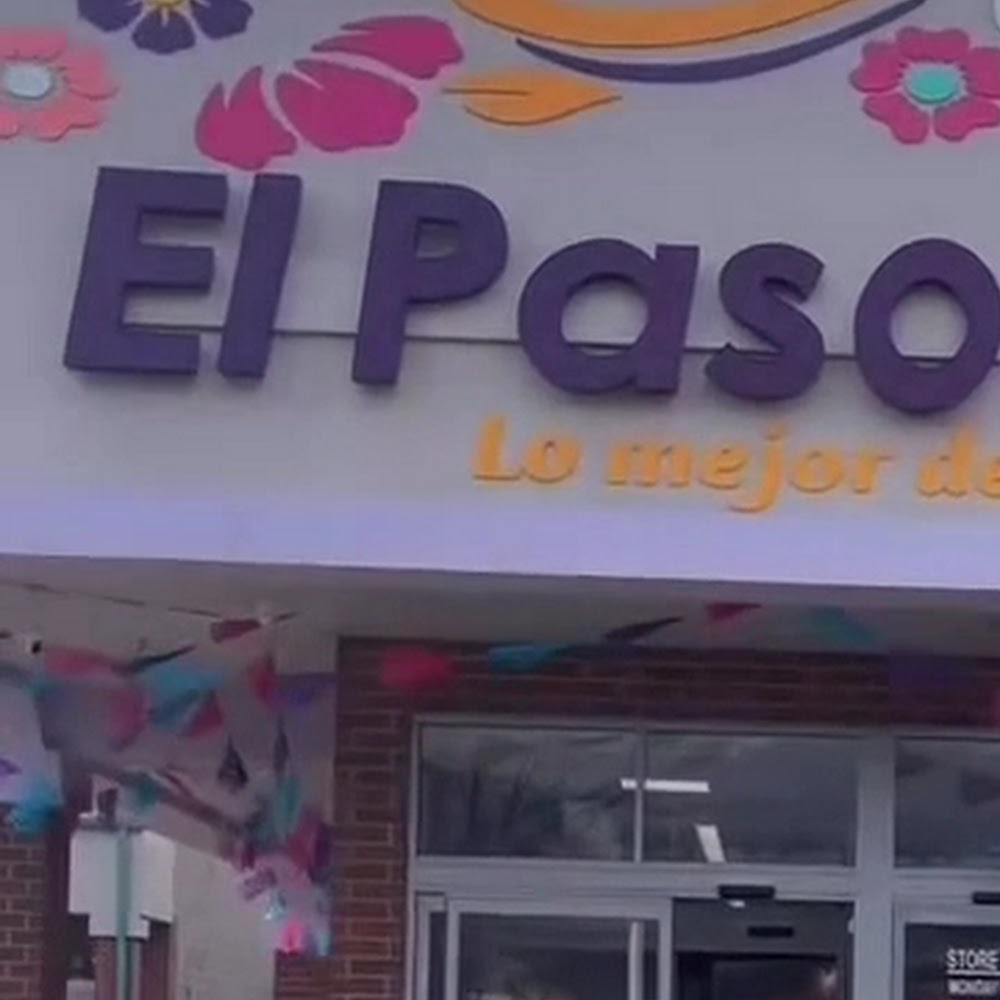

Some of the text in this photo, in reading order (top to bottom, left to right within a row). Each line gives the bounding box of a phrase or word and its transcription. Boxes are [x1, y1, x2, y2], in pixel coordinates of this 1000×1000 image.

[64, 166, 303, 380] El
[472, 414, 580, 484] Lo
[604, 422, 893, 513] mejor
